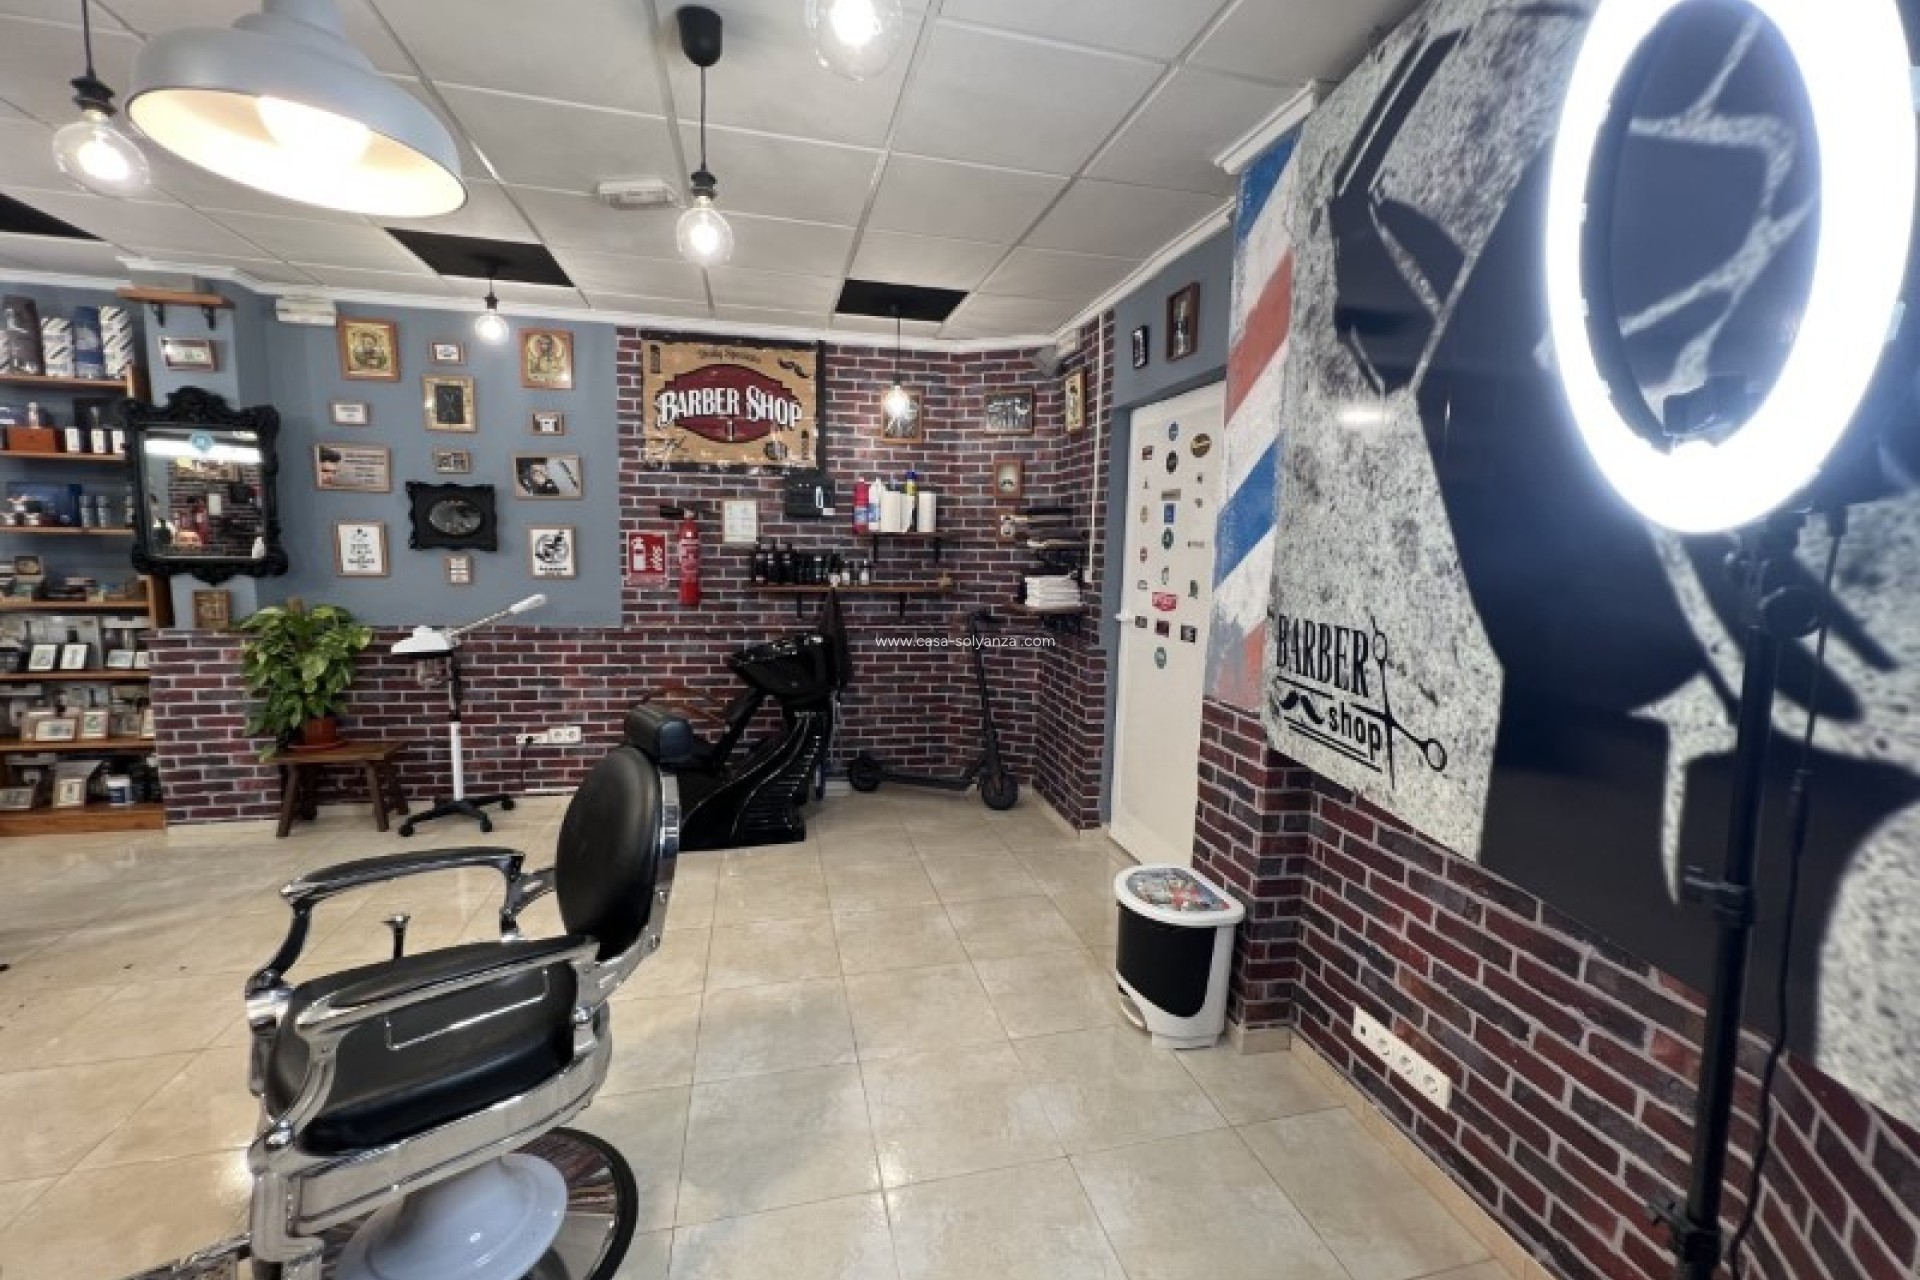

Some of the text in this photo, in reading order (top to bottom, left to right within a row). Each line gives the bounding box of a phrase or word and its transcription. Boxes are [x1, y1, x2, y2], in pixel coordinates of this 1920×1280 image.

[656, 384, 803, 428] BARBER SHOP
[1276, 615, 1369, 698] BARBER
[1328, 701, 1382, 761] shop
